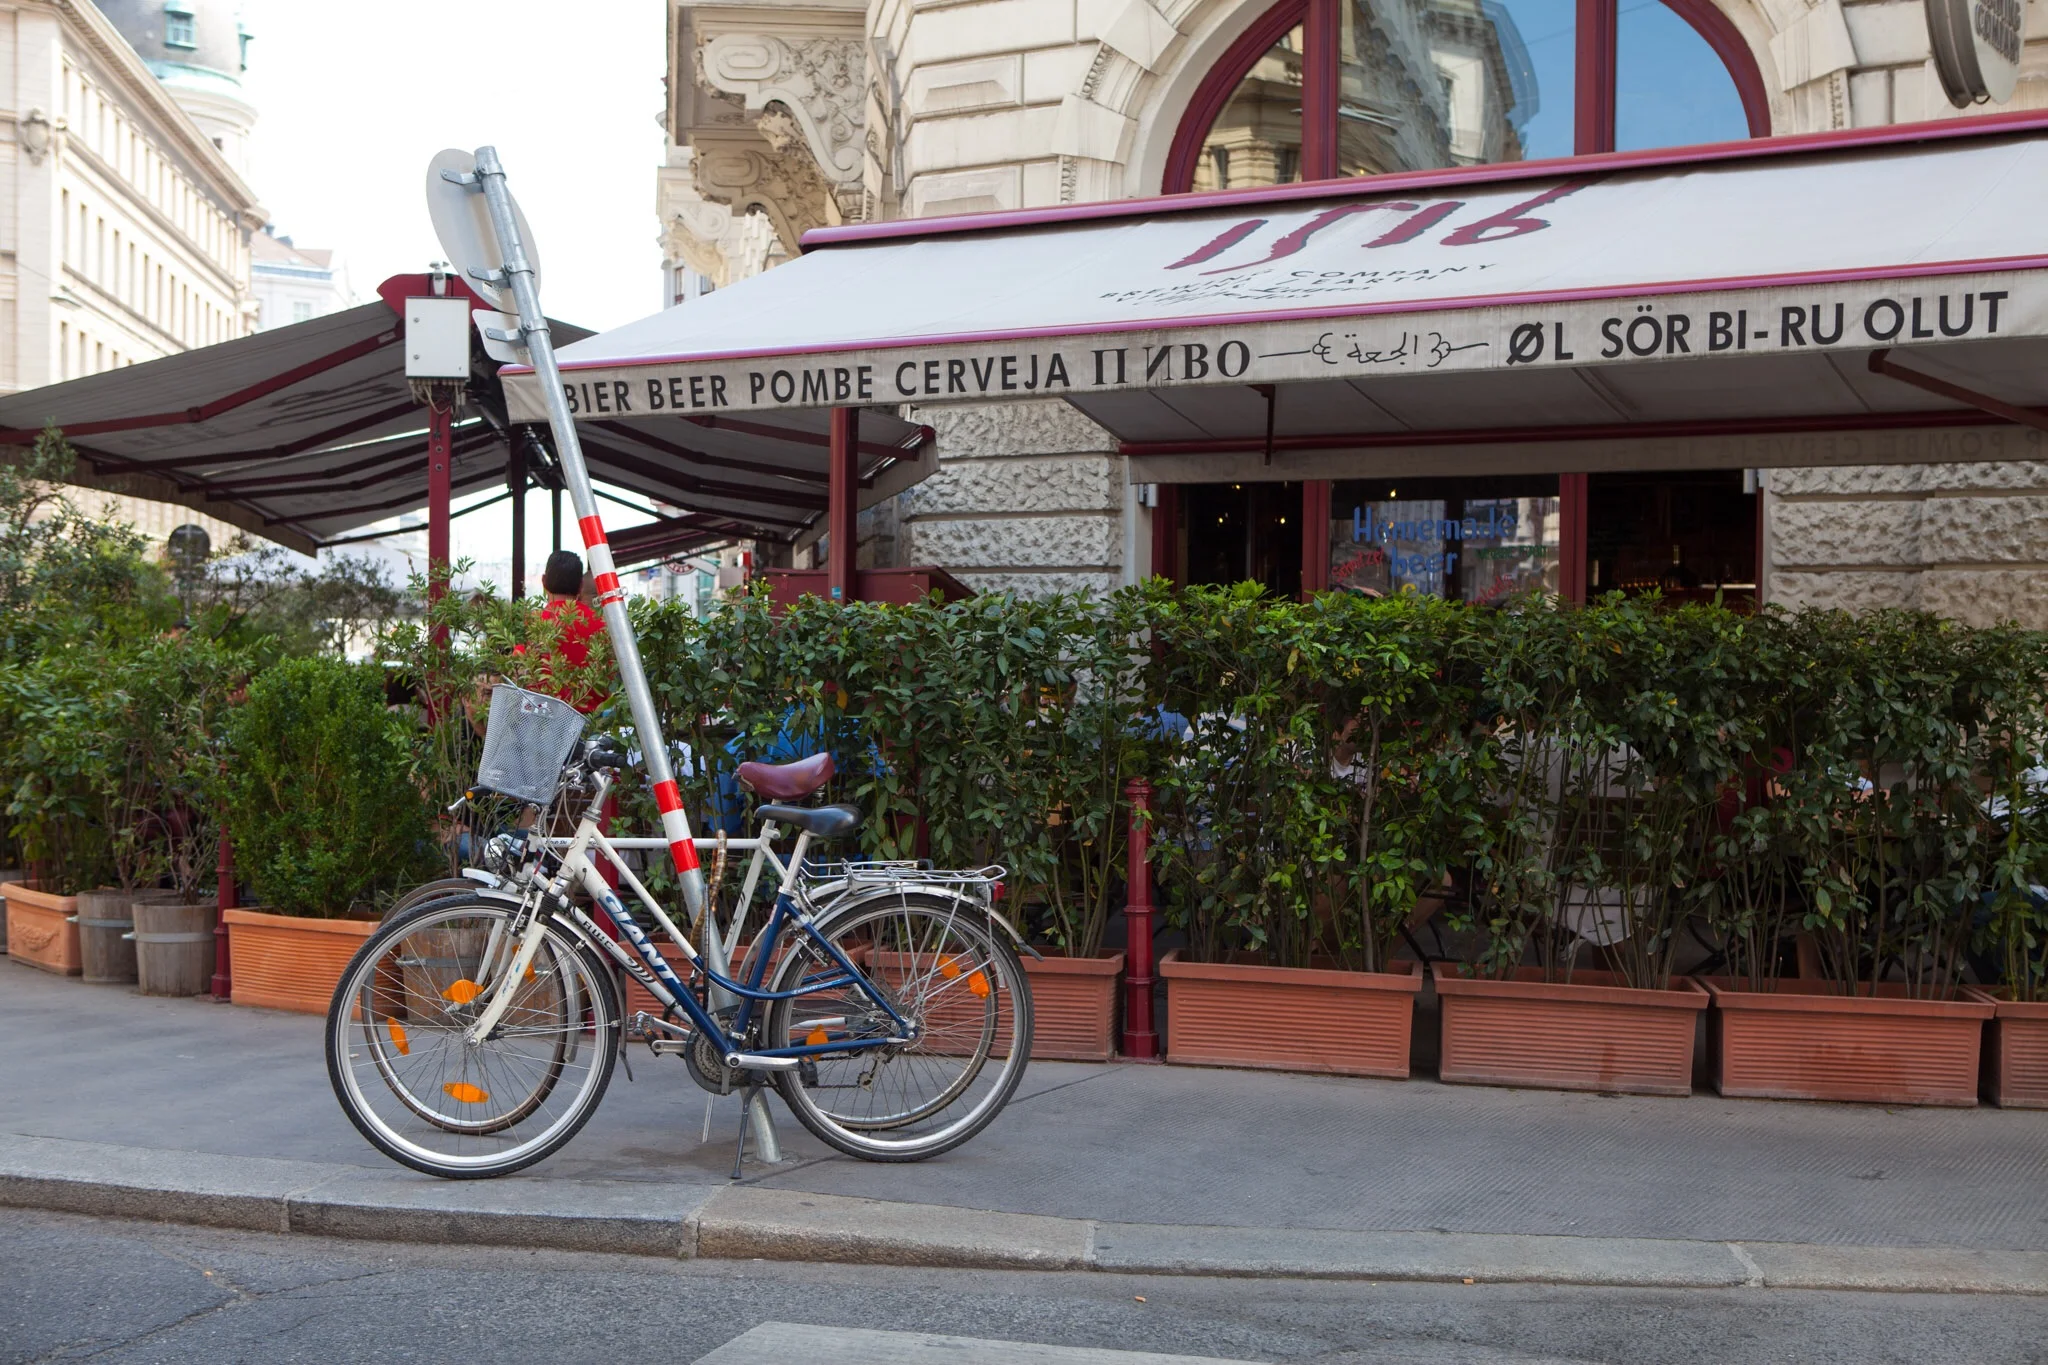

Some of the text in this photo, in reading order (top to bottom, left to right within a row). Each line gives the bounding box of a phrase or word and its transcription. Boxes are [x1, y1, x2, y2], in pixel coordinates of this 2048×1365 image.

[1290, 263, 1497, 278] COMPANY
[1312, 275, 1438, 285] EARTH
[1506, 321, 1574, 366] ØL
[1600, 305, 1690, 358] SÖR
[1864, 290, 2008, 342] OLUT
[564, 352, 1071, 415] BIER BEER POMBE CERVEJA
[1353, 506, 1516, 543] Homemade
[1390, 547, 1458, 577] beer
[598, 888, 682, 984] GIANT
